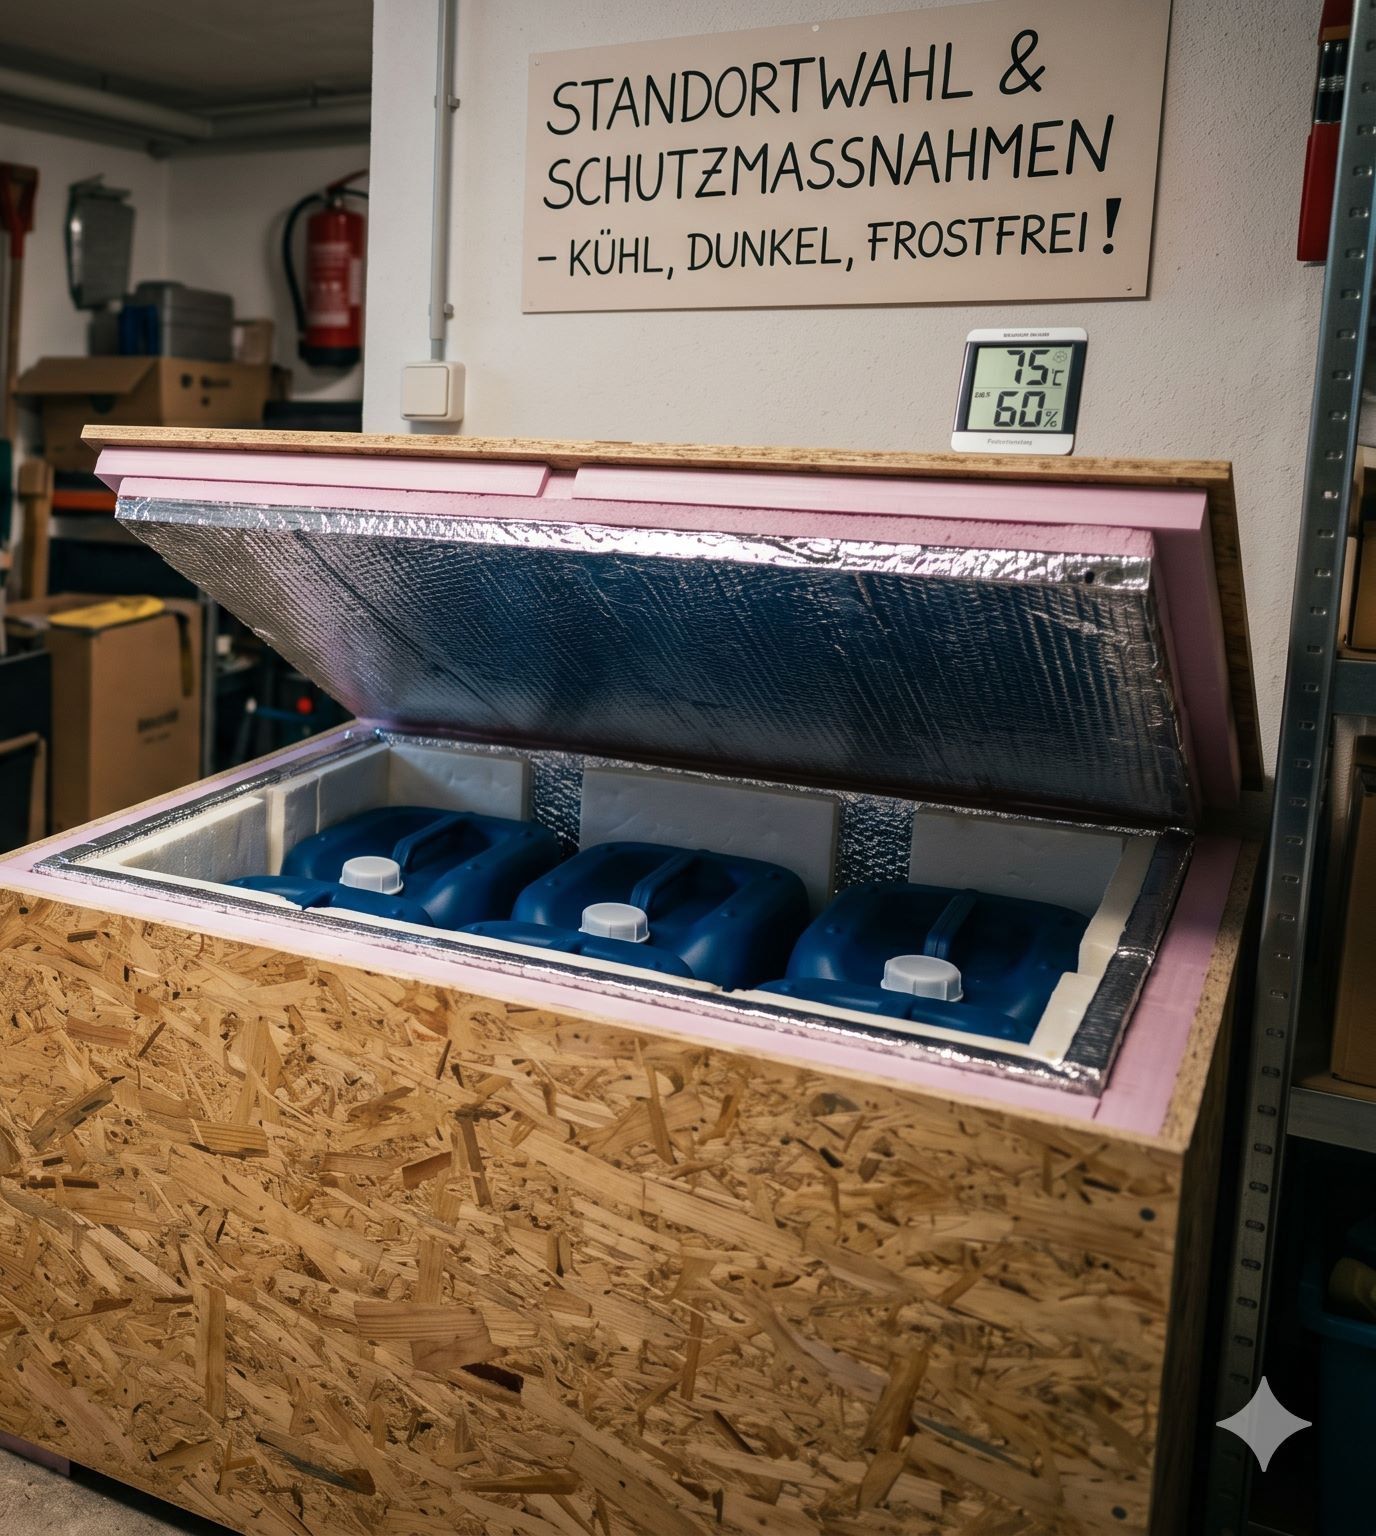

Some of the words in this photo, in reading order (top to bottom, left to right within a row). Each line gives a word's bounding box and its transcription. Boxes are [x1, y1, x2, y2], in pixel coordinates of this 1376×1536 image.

[546, 41, 975, 136] STANDORTWAHL
[998, 28, 1046, 96] &
[543, 113, 1115, 210] SCHUTZMASSNAHMEN
[569, 228, 674, 281] KÜHL,
[687, 226, 854, 272] DUNKEL,
